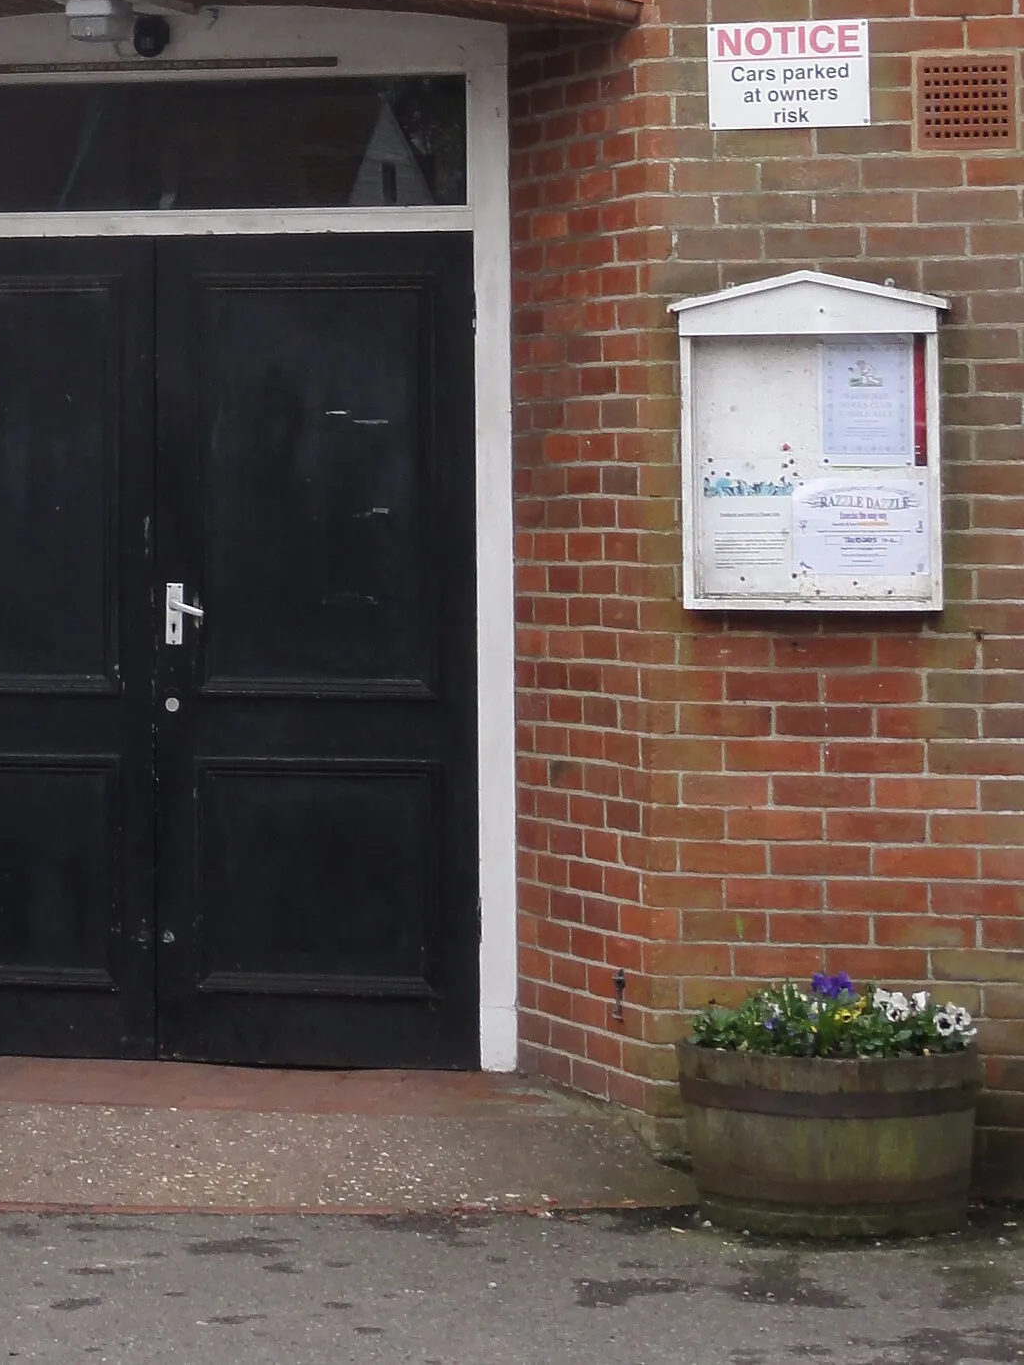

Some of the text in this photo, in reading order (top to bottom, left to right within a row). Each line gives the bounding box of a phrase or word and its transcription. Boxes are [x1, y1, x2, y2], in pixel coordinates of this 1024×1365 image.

[717, 25, 860, 56] NOTICE
[731, 64, 849, 84] Cars parked
[744, 88, 838, 103] at owners
[774, 108, 809, 123] risk
[820, 494, 910, 511] RAZZLE DAZZLE
